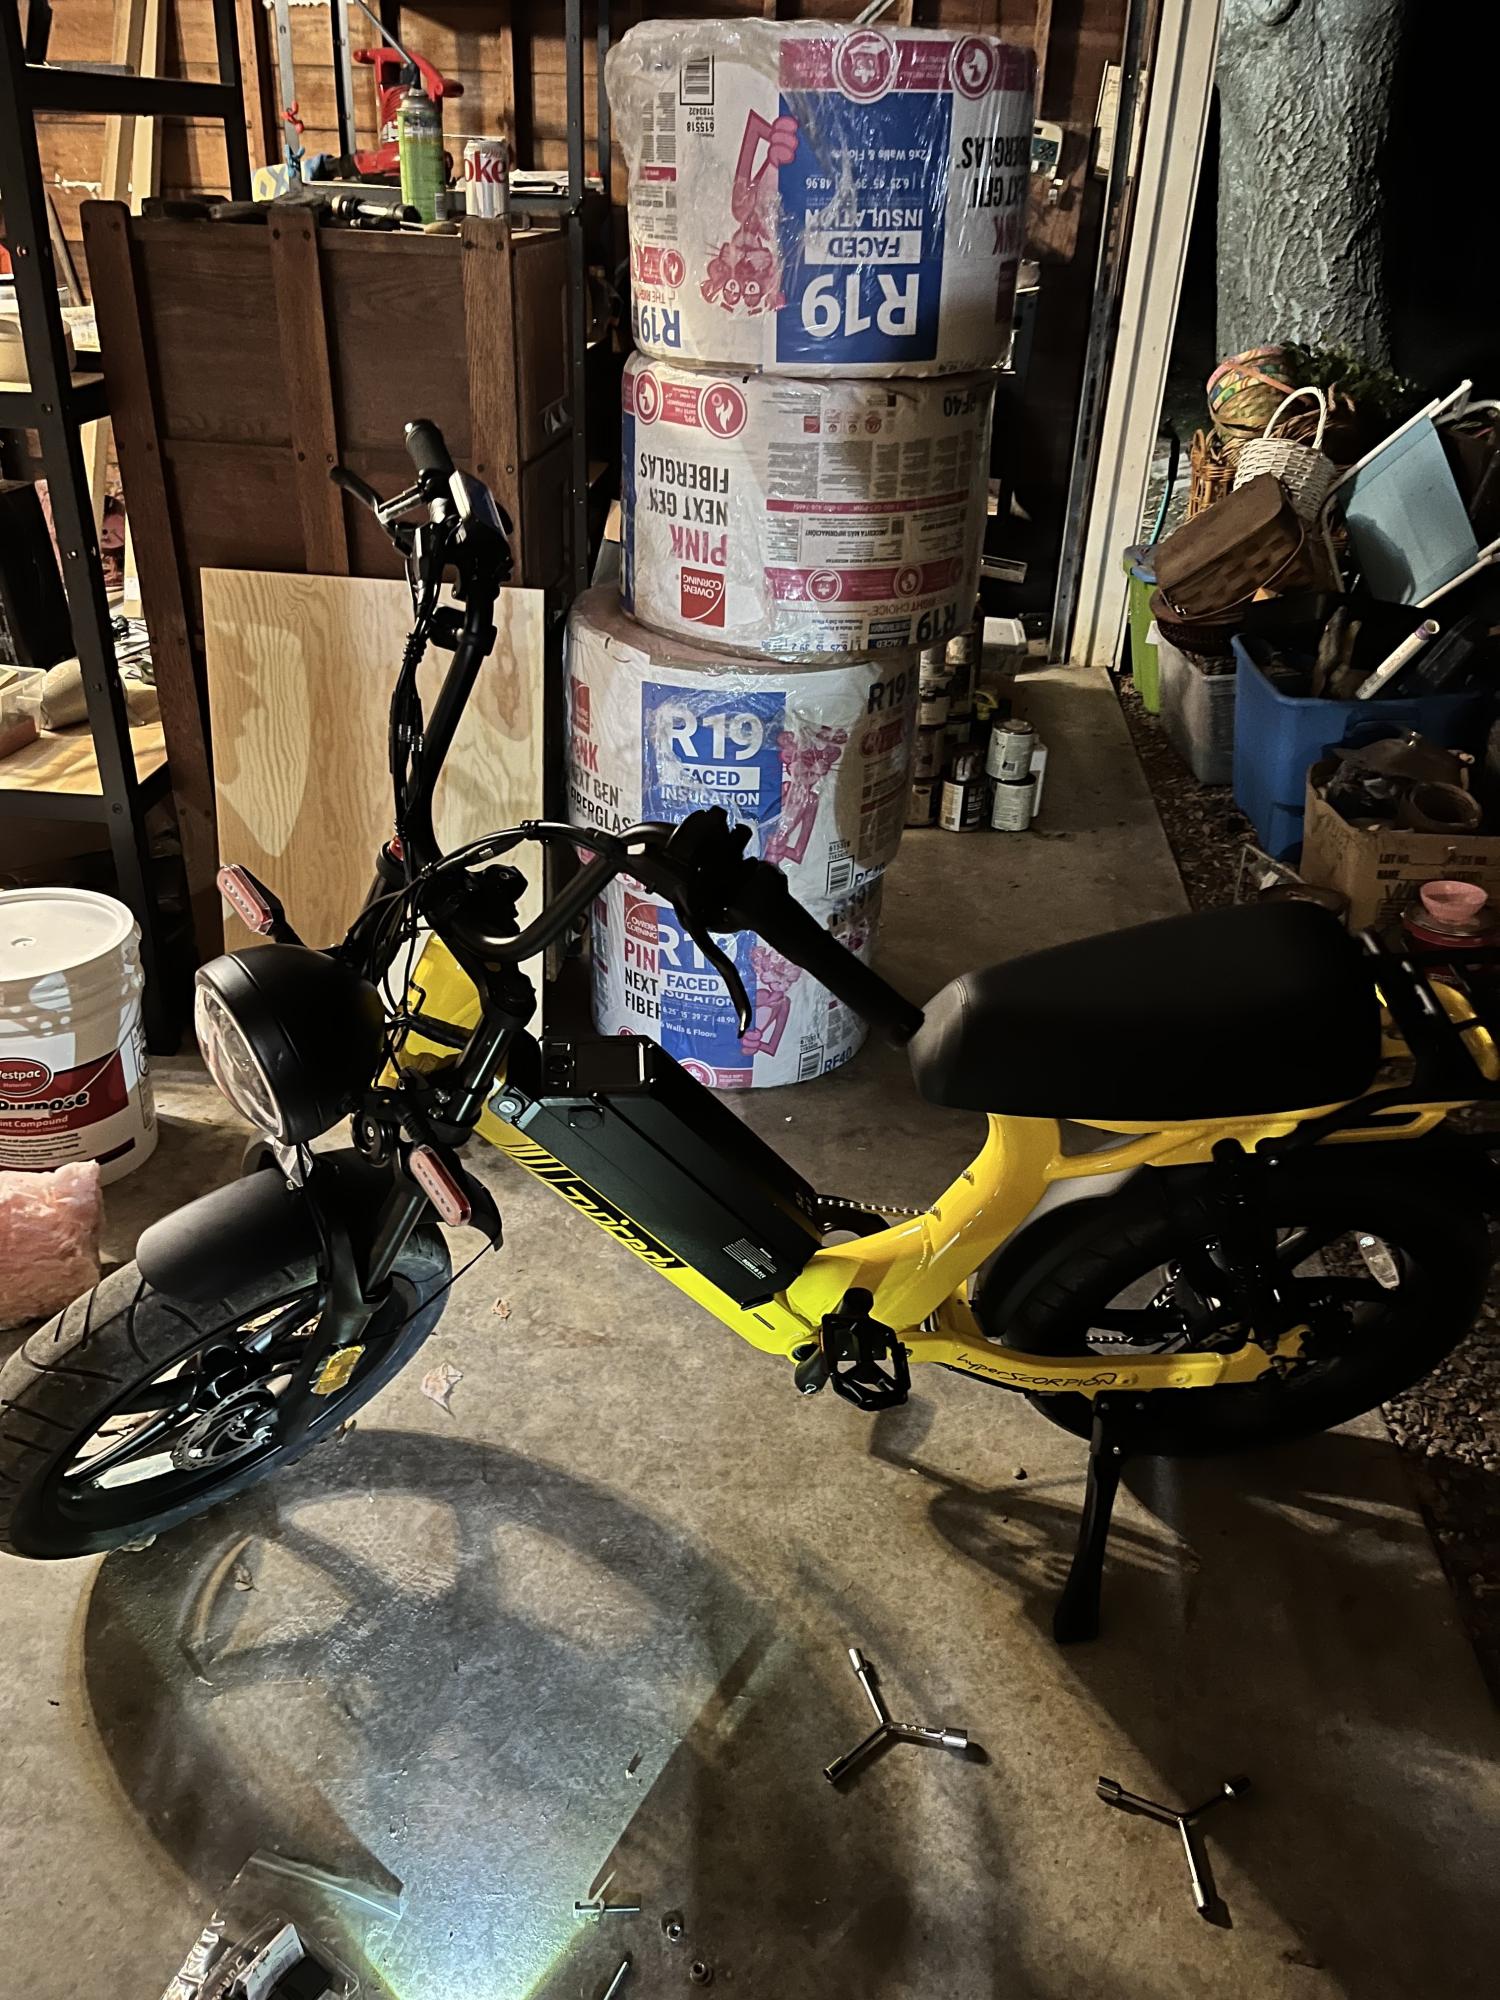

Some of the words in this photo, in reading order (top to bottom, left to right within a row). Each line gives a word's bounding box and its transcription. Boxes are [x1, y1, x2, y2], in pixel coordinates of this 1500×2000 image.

[686, 121, 714, 133] 615518
[465, 150, 507, 184] oke
[804, 208, 923, 227] INSULATION
[828, 236, 901, 258] FACED
[801, 272, 920, 338] R19
[641, 305, 681, 348] R19
[640, 452, 729, 494] FIBERGLAS
[648, 487, 677, 518] GEN
[682, 496, 729, 527] NEXT
[668, 523, 728, 567] PINK
[682, 573, 722, 591] CORNING
[682, 583, 715, 599] OWENS
[873, 602, 909, 616] CHOICE
[868, 672, 907, 715] R19
[661, 703, 764, 761] R19
[593, 779, 619, 809] GEN
[625, 922, 658, 940] CORNING
[630, 916, 658, 933] OWENS
[624, 938, 661, 975] PIN
[625, 967, 659, 997] NEXT
[666, 973, 719, 992] FACED
[824, 1046, 853, 1073] RF40
[14, 1114, 69, 1129] Compound
